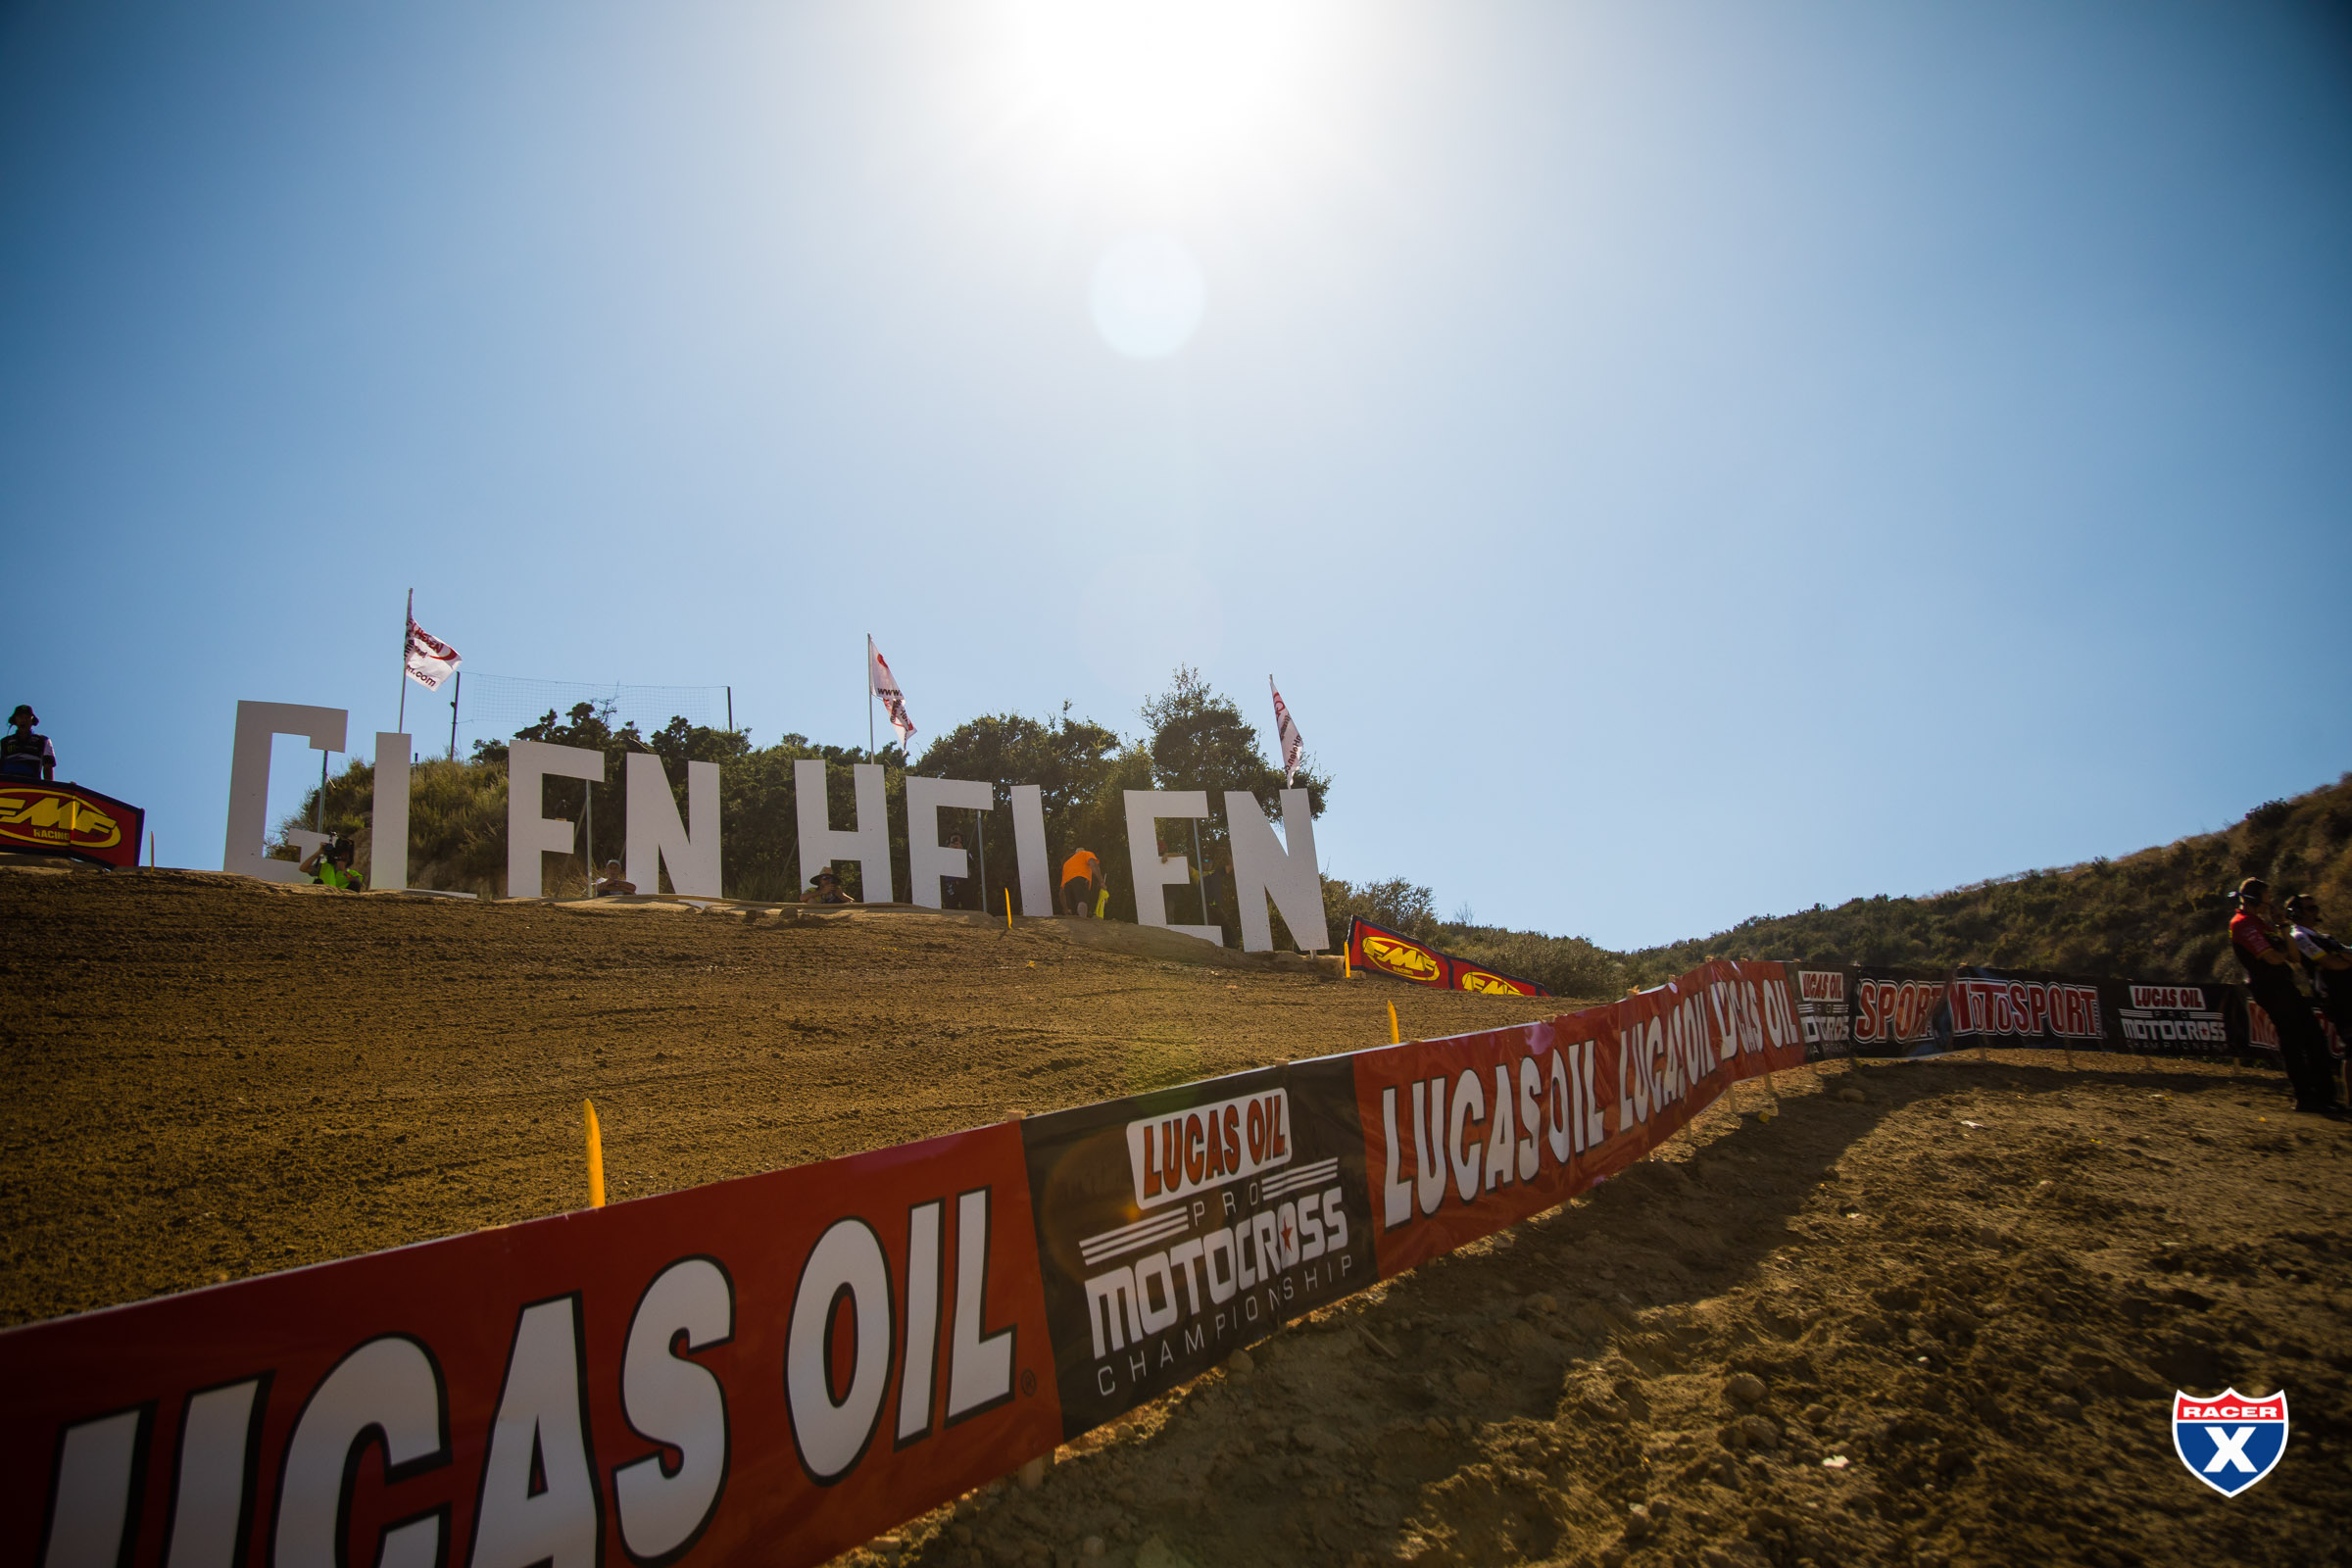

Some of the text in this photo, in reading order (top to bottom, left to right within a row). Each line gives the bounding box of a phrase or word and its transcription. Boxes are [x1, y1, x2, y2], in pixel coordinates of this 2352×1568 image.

[33, 828, 70, 841] RACING
[1363, 938, 1437, 972] FMF
[1830, 974, 1842, 1000] OIL
[1764, 979, 1799, 1049] OIL
[2121, 1018, 2227, 1042] MOTOCROSS
[2133, 987, 2204, 1008] LUCAS OIL
[1683, 990, 1716, 1086] OIL
[1143, 1094, 1287, 1201] LUCAS OIL
[1382, 1039, 1605, 1233] LUCAS OIL
[1192, 1181, 1260, 1227] PRO
[1084, 1186, 1349, 1360] MOTOCROSS
[785, 1185, 1017, 1488] OIL
[1097, 1253, 1353, 1397] CHAMPIONSHIP
